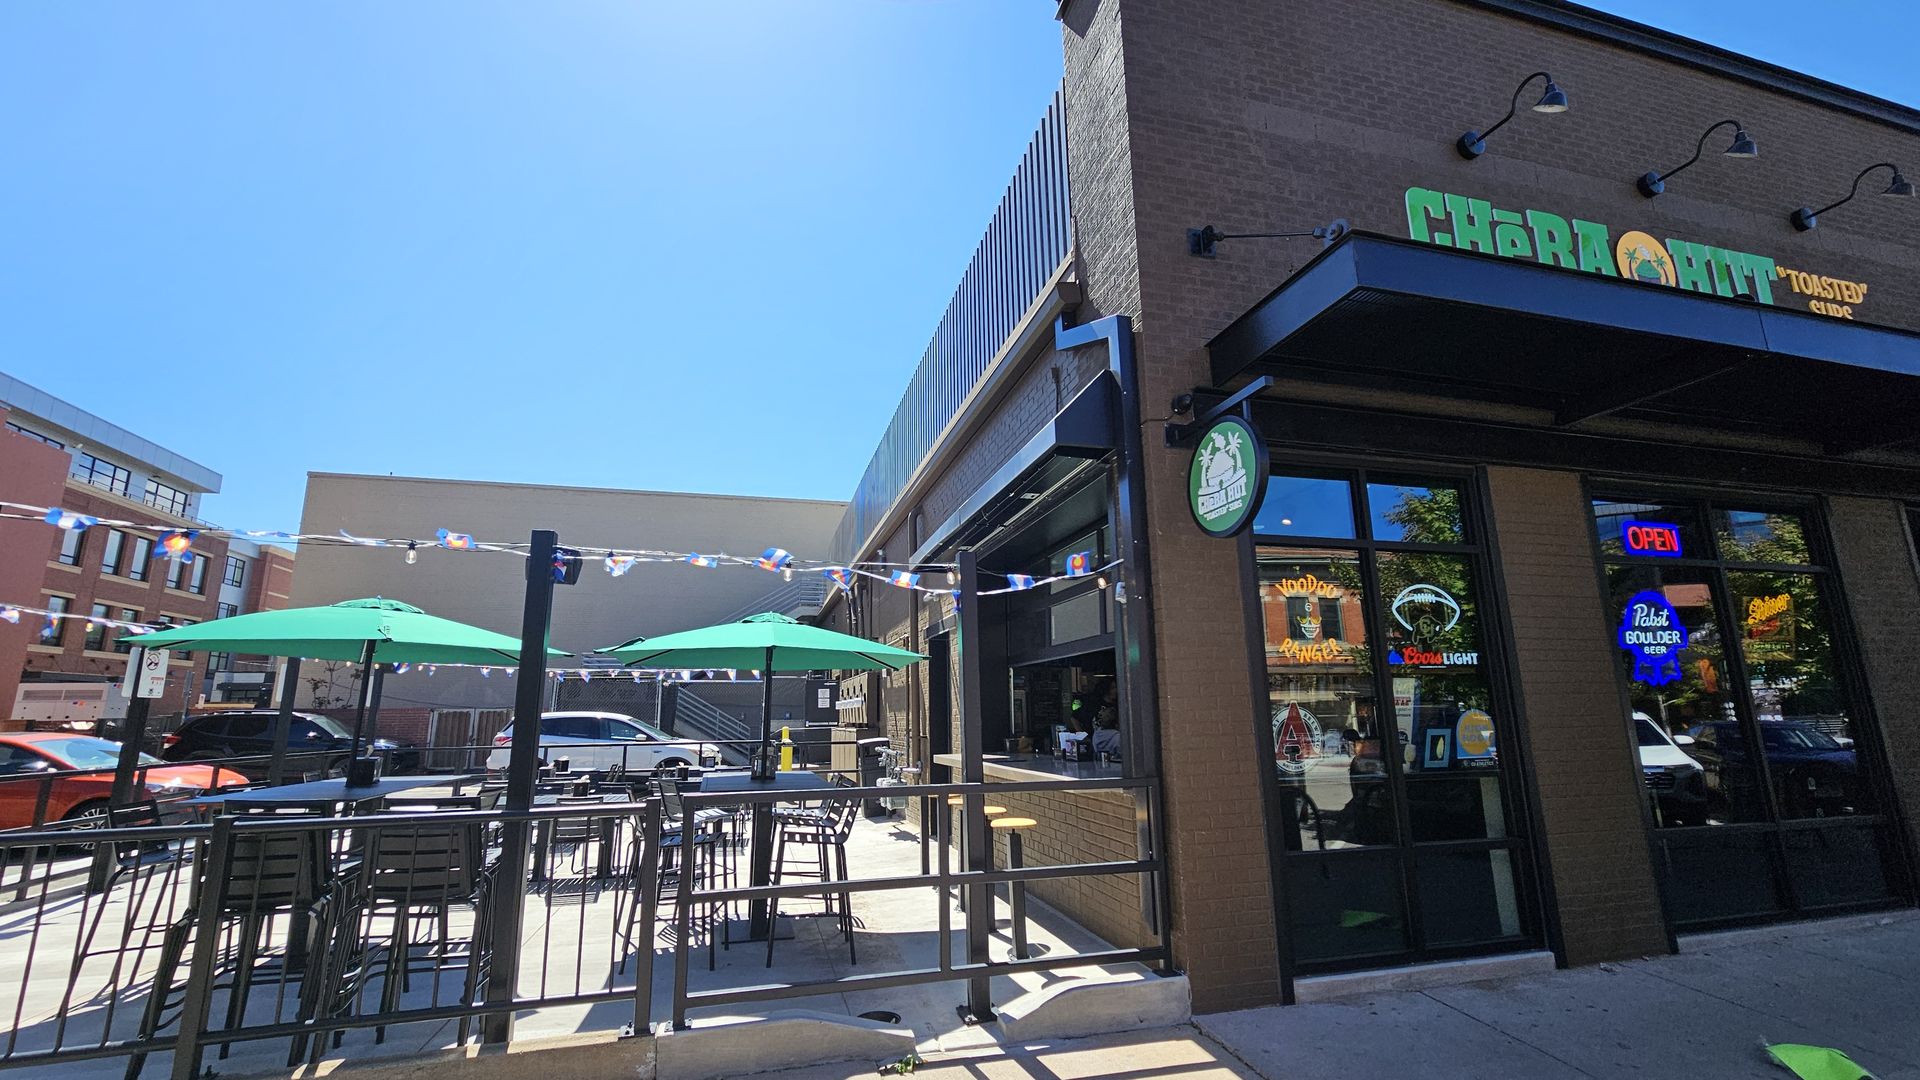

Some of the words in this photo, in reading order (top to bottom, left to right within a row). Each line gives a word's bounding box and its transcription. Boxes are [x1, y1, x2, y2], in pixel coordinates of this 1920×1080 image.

[1665, 238, 1778, 305] HUT
[1776, 266, 1868, 304] "TOASTED"
[1627, 526, 1679, 551] OPEN
[1275, 574, 1337, 598] VOODOO
[1633, 603, 1669, 627] Pabst
[1625, 631, 1681, 645] BOULDER
[1279, 638, 1342, 663] RANGER
[1402, 646, 1442, 665] Coors
[1442, 653, 1478, 665] LIGHT
[1643, 646, 1667, 655] BEER
